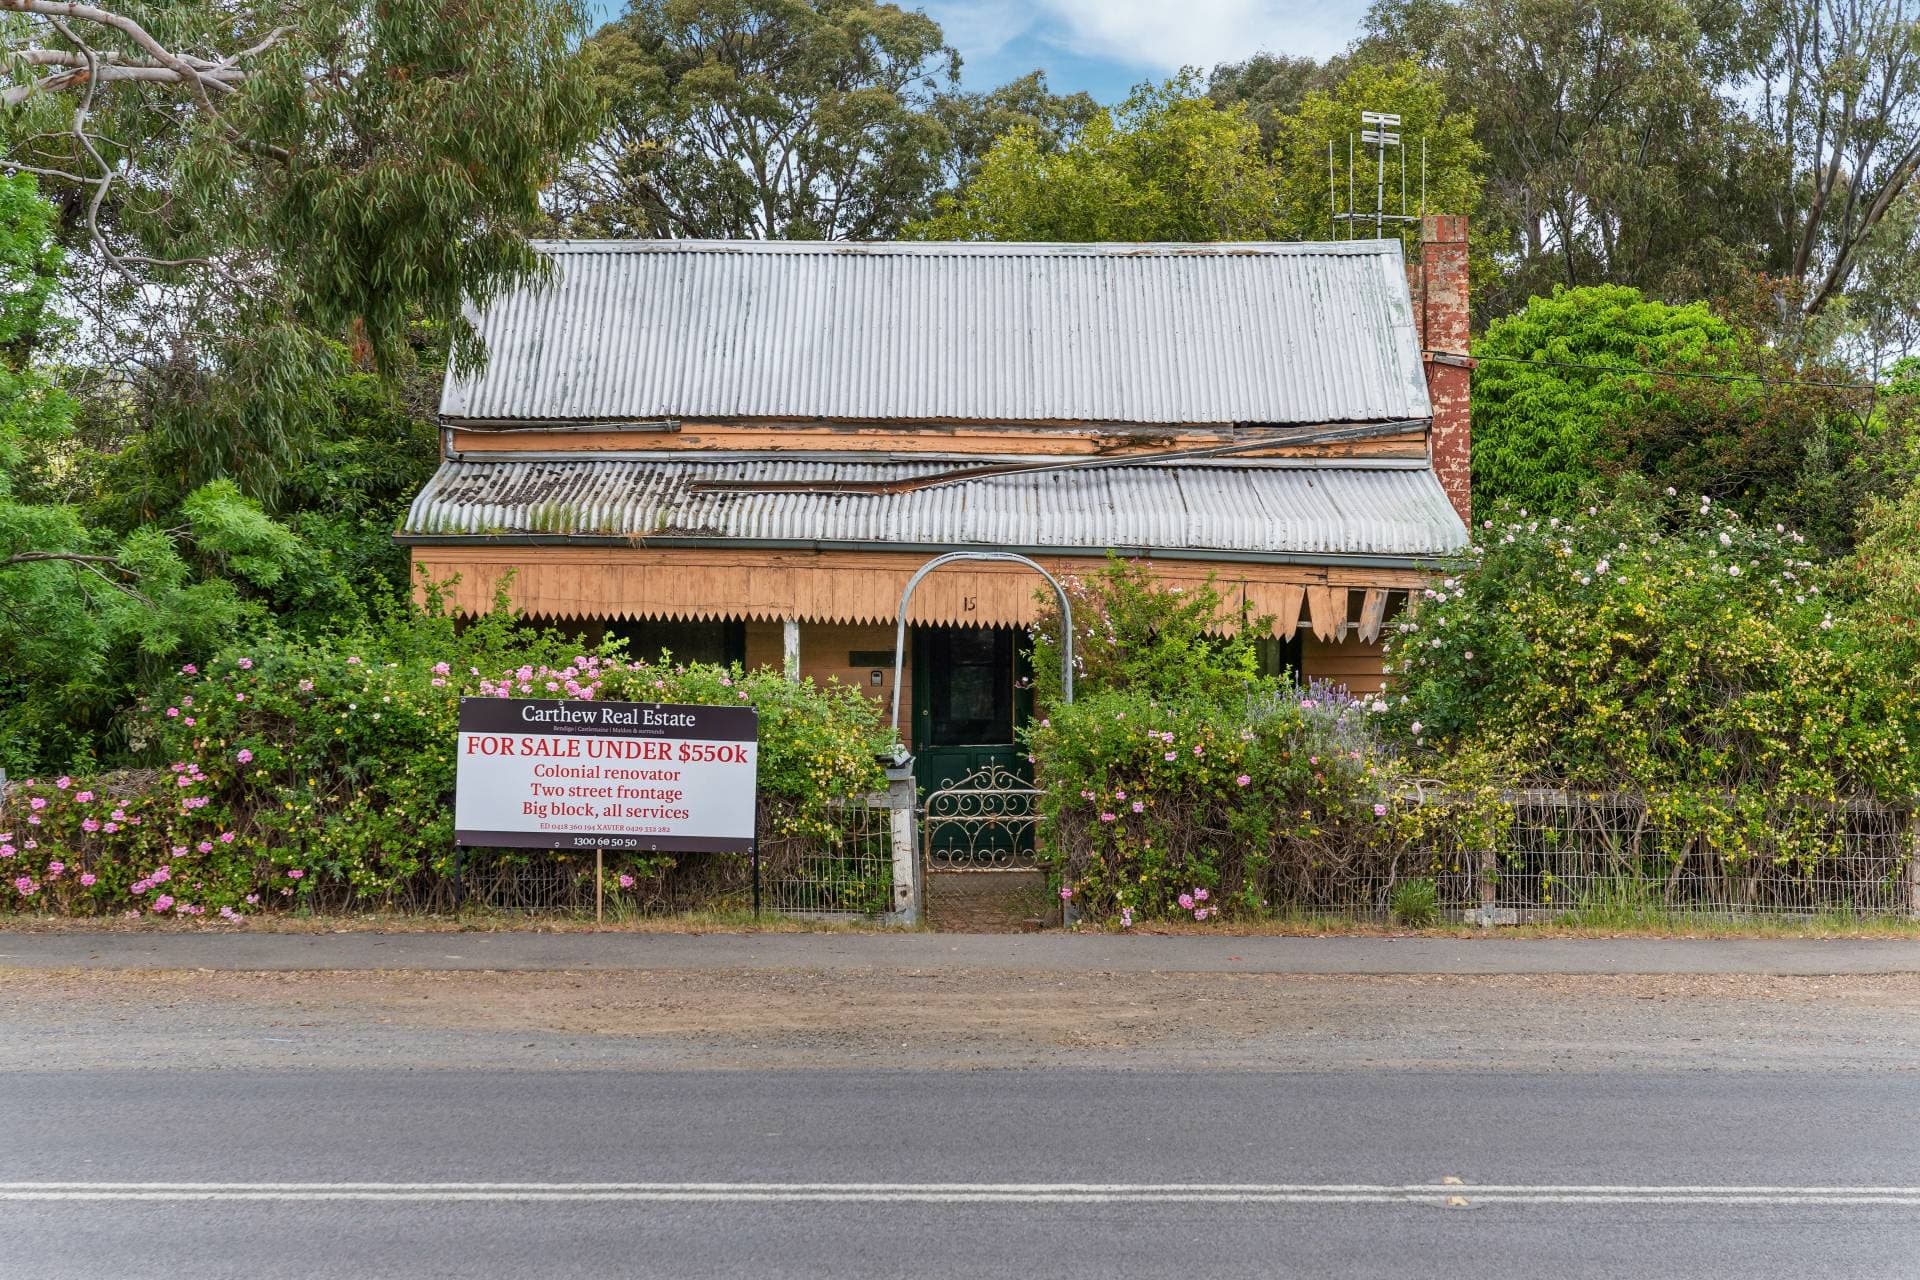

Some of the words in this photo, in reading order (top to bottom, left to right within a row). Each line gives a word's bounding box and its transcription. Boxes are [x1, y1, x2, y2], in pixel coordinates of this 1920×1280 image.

[964, 597, 977, 612] 15
[522, 706, 597, 723] Carthew
[601, 709, 638, 725] Real
[643, 710, 696, 726] Estate
[467, 736, 514, 756] FOR
[521, 738, 580, 757] SALE
[587, 740, 672, 760] UNDER
[679, 742, 748, 763] $550k
[534, 764, 600, 779] Colonial
[604, 767, 680, 781] renovator
[531, 783, 564, 797] Two
[569, 785, 613, 798] street
[617, 785, 682, 803] frontage
[523, 801, 547, 818] Big
[551, 802, 599, 819] block,
[603, 804, 622, 817] all
[626, 805, 689, 819] services
[574, 837, 595, 846] 1300
[611, 838, 623, 847] 50
[625, 838, 637, 847] 50
